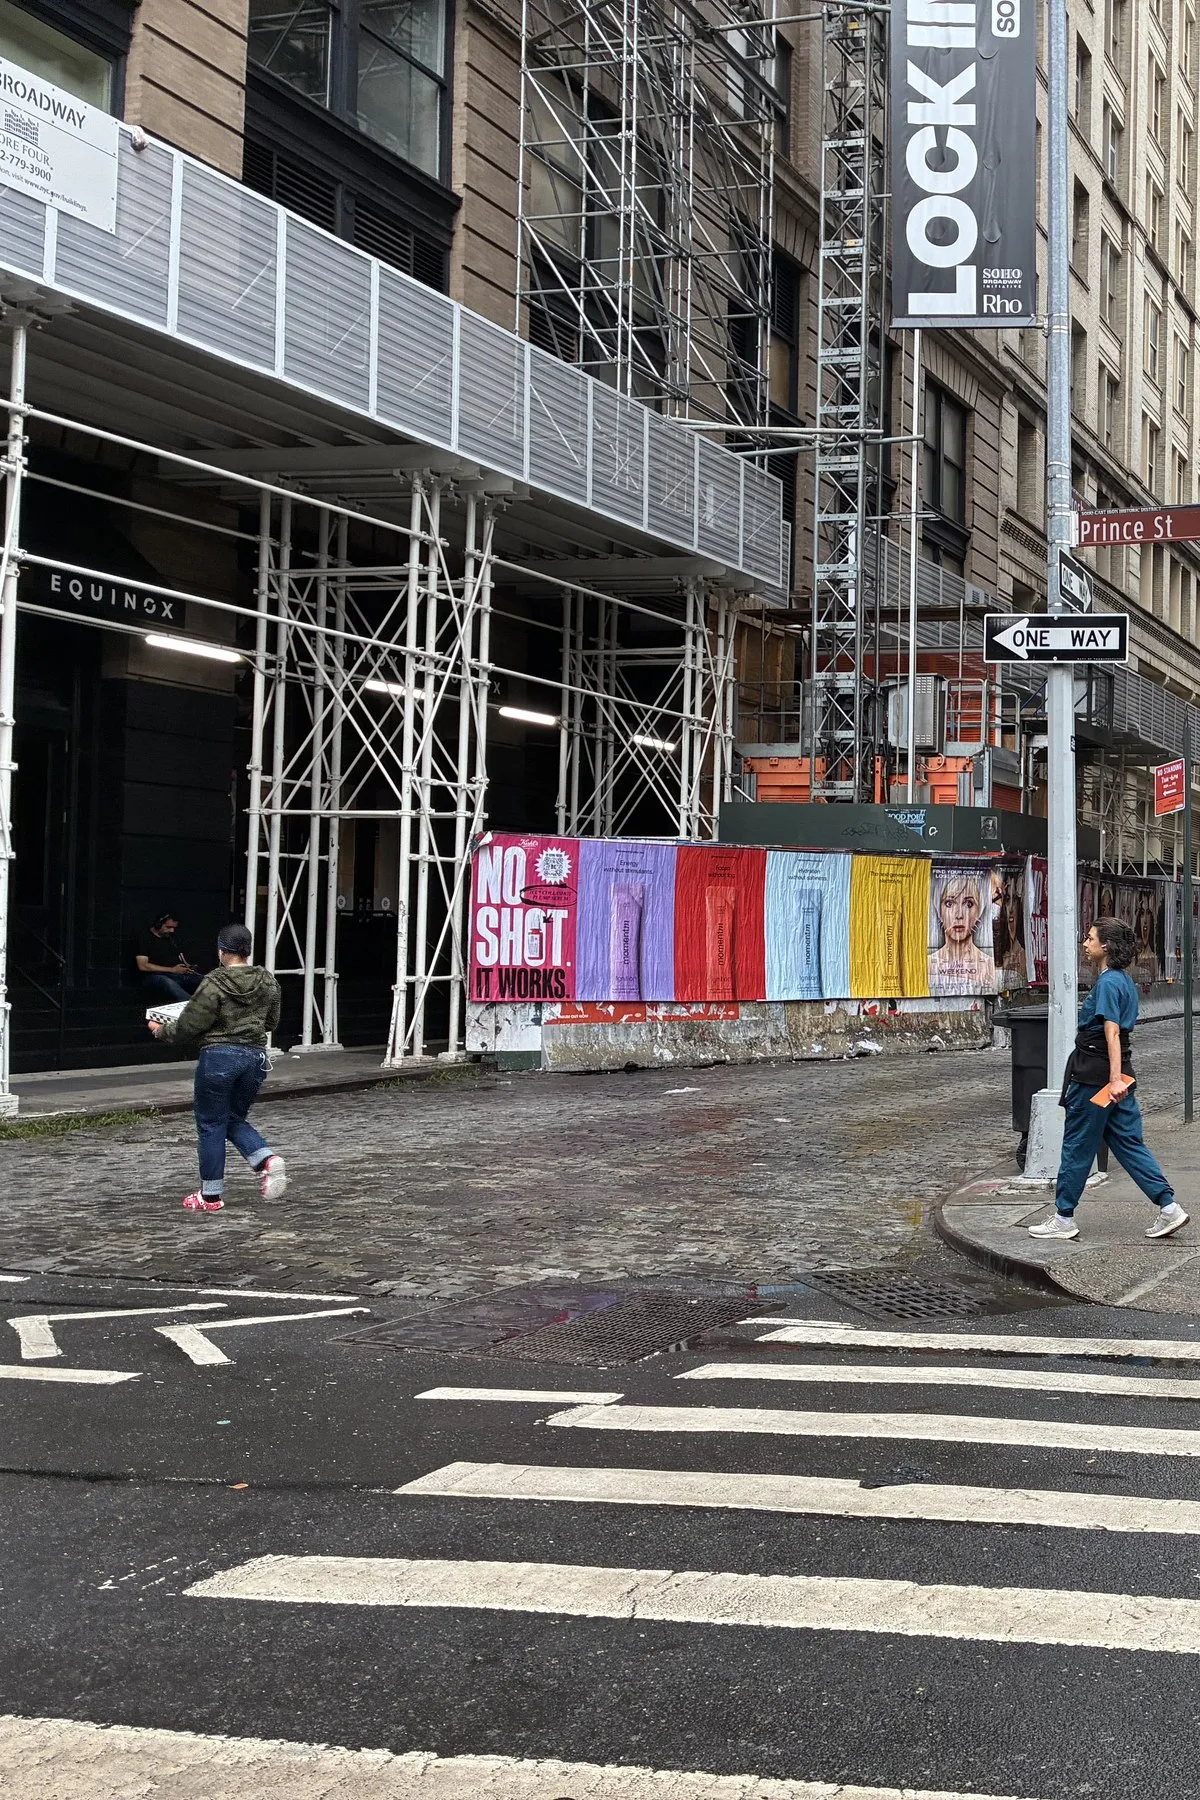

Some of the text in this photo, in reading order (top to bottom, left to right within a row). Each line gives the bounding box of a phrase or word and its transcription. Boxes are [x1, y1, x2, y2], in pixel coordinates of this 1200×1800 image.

[0, 73, 86, 130] ROADWAY
[0, 133, 50, 167] ORE FOUR
[905, 59, 978, 315] LOCK
[982, 268, 1023, 279] SOHO
[983, 294, 1023, 314] Rho
[1081, 515, 1173, 543] Prince St
[1062, 566, 1075, 592] ONE
[51, 574, 174, 620] EQUINOX
[1012, 629, 1112, 647] ONE WAY
[477, 846, 527, 906] NO
[619, 859, 639, 867] Energy
[476, 967, 571, 999] IT WORKS.
